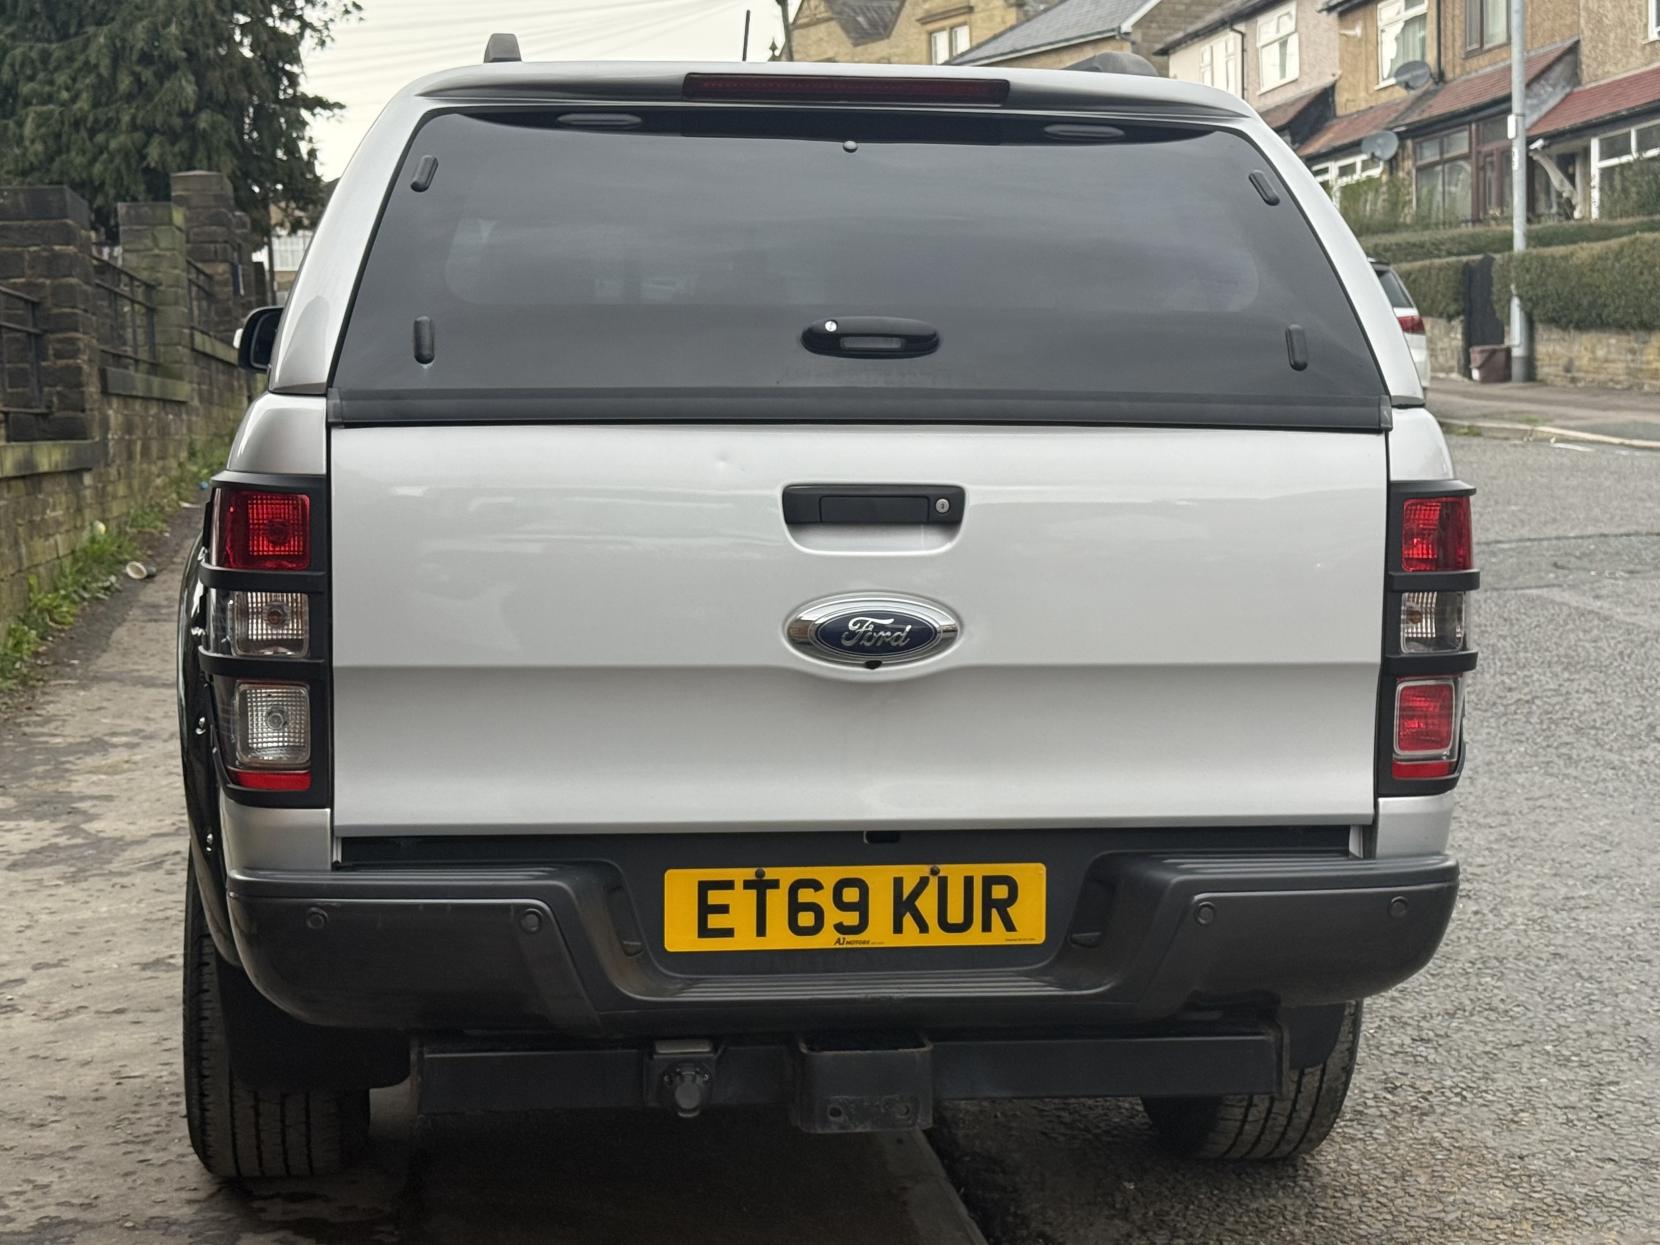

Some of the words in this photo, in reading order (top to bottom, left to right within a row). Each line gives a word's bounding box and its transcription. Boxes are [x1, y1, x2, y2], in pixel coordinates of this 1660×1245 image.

[841, 616, 912, 647] Ford
[697, 877, 870, 938] ET69
[892, 874, 1018, 935] KUR
